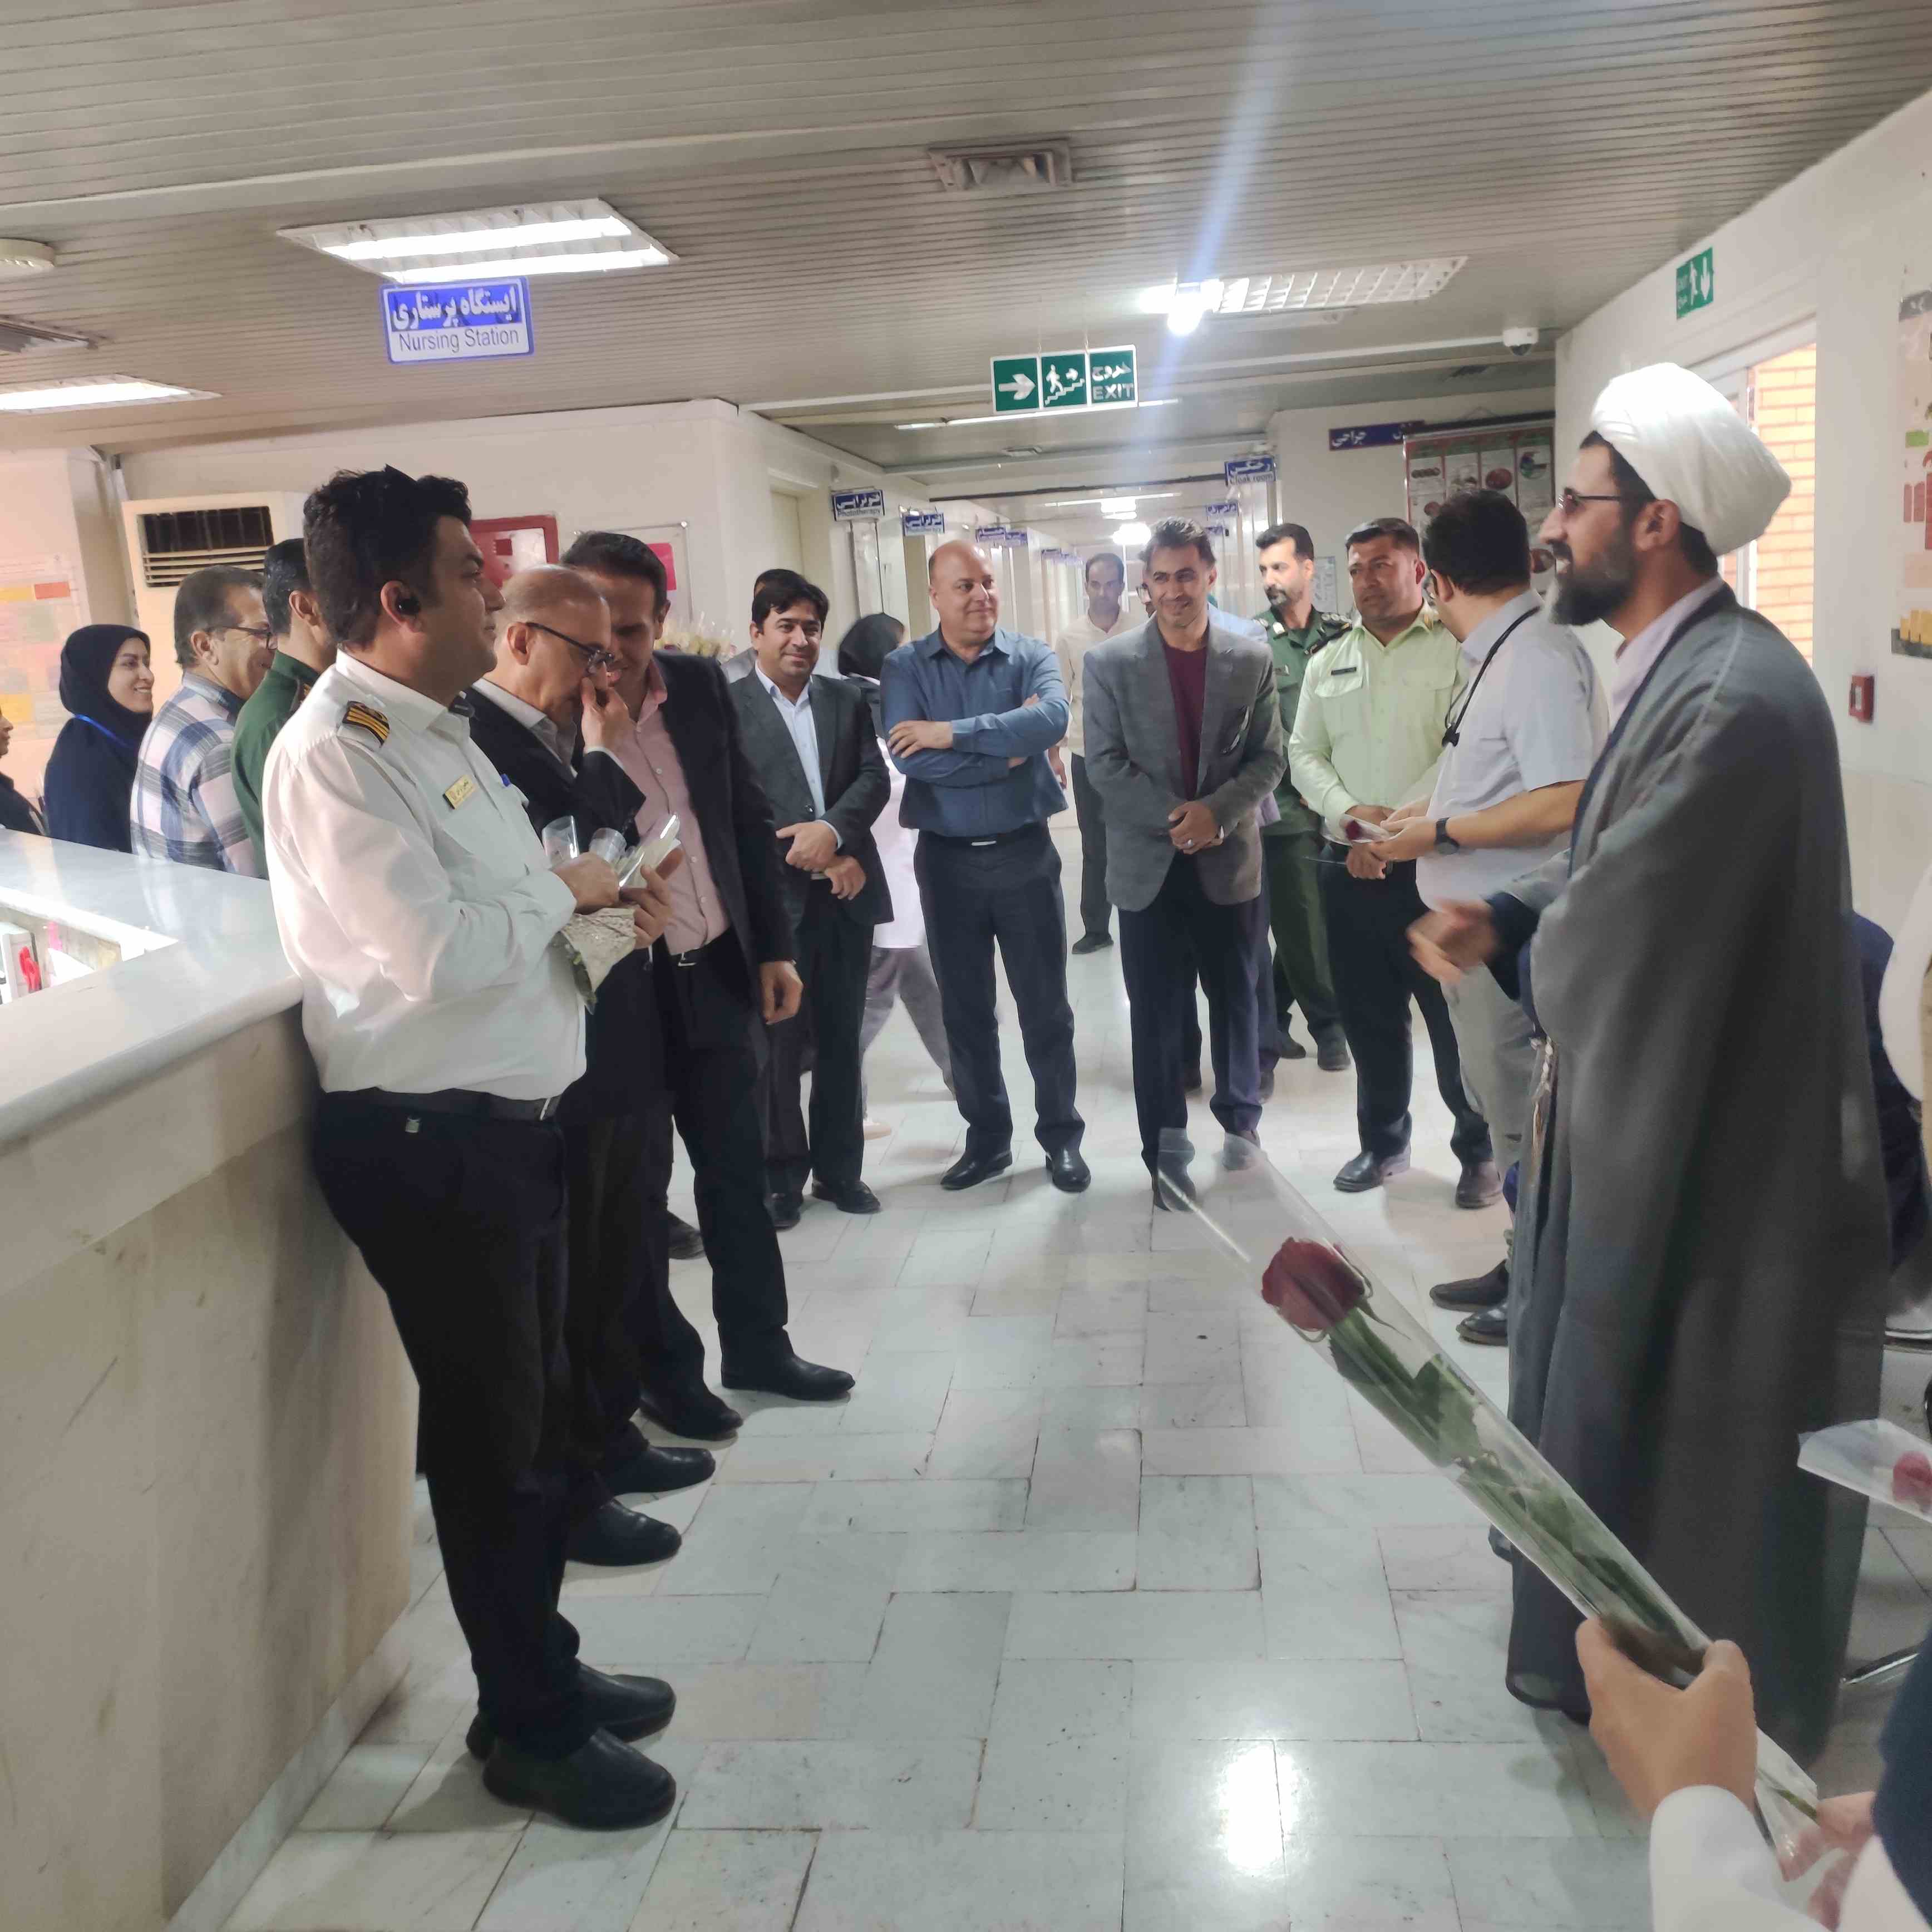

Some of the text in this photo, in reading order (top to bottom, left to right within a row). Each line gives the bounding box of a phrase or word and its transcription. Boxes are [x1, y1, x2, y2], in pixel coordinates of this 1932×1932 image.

[392, 285, 516, 330] ایستگاه پرستاری
[399, 327, 519, 353] Nursing Station
[1092, 382, 1134, 400] EXIT
[1230, 474, 1251, 485] Cloak
[836, 508, 881, 518] Phototherapy
